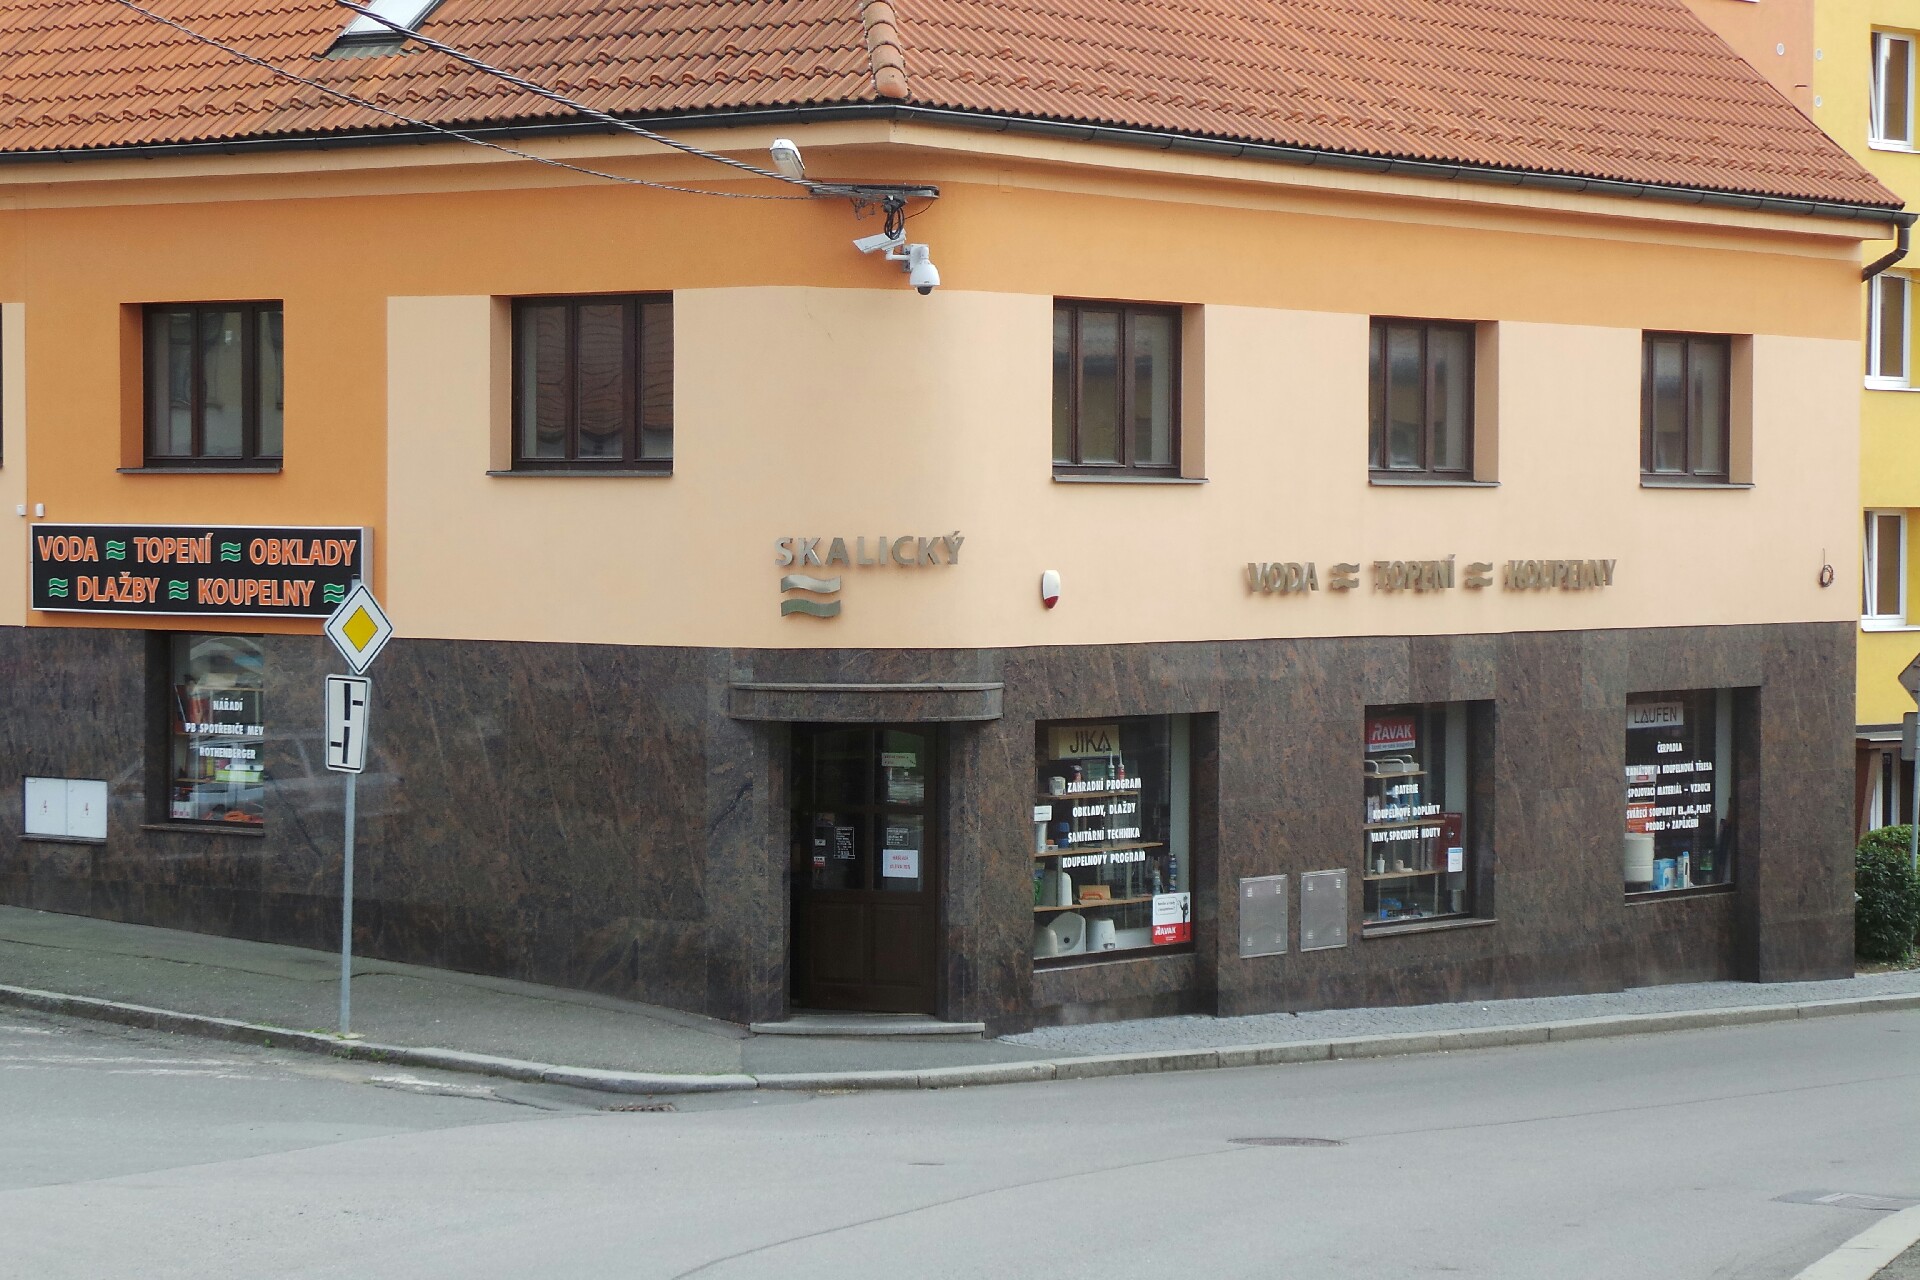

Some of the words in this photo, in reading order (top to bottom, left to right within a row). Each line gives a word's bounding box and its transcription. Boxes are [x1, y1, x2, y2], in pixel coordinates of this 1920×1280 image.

[38, 536, 98, 562] VODA
[133, 533, 214, 564] TOPENÍ
[249, 539, 357, 566] OBKLADY
[775, 530, 965, 566] SKALICKÝ
[1247, 562, 1319, 592] VODA
[1373, 554, 1456, 590] TOPENÍ
[1507, 559, 1617, 589] KOUPELNY
[77, 572, 160, 603] DLAŽBY
[198, 578, 315, 607] KOUPELNY
[213, 698, 243, 711] NÁŘADÍ
[1634, 706, 1677, 724] LAUFEN
[185, 723, 197, 733] PB
[199, 722, 244, 735] SPOTŘEBIČE
[1372, 722, 1412, 740] RAVAK
[1069, 730, 1113, 754] JIKA
[1657, 741, 1683, 753] ČERPADLA
[199, 747, 256, 760] ROTHENBERGER
[1657, 765, 1661, 774] A
[1662, 761, 1694, 774] KOUPELNOVÁ
[1695, 760, 1712, 771] TĚLESA
[1067, 778, 1104, 793] ZAHRADNÍ
[1106, 777, 1142, 791] PROGRAM
[1395, 783, 1419, 795] BATERIE
[1657, 782, 1682, 795] MATERIÁL
[1072, 804, 1106, 818] OBKLADY,
[1108, 801, 1136, 815] DLAŽBY
[1373, 805, 1410, 819] KOUPELNOVÉ
[1412, 803, 1440, 816] DOPLŇKY
[1649, 806, 1676, 817] SOUPRAVY
[1421, 828, 1440, 838] KOUTY
[1645, 821, 1666, 832] PRODEJ
[1067, 827, 1105, 844] SANITÁRNÍ
[1107, 826, 1141, 841] TECHNIKA
[1062, 851, 1107, 869] KOUPELNOVÝ
[1110, 850, 1146, 865] PROGRAM
